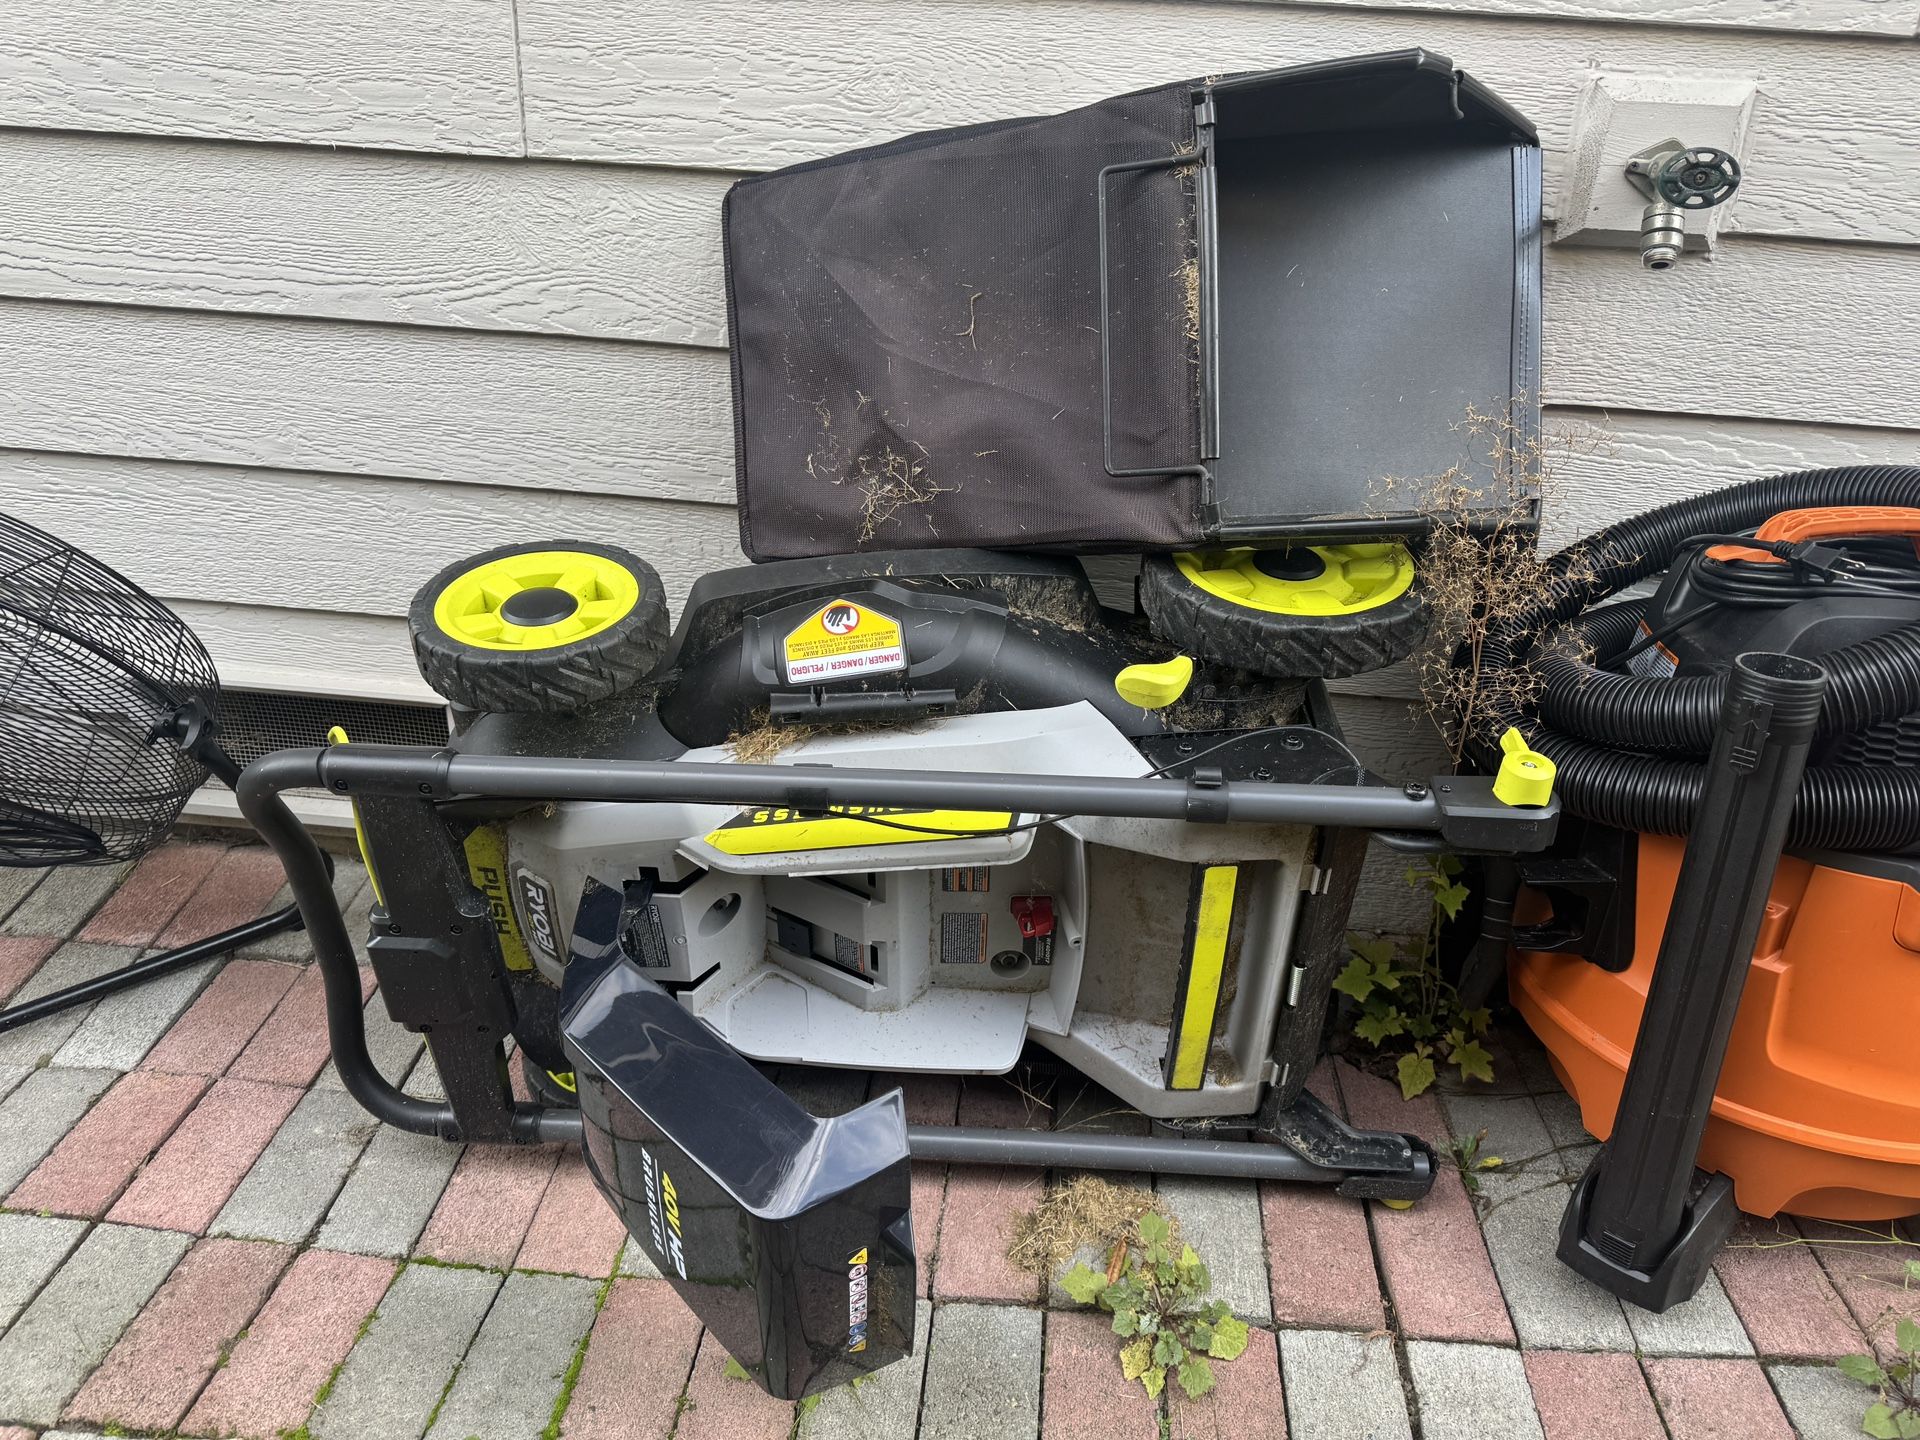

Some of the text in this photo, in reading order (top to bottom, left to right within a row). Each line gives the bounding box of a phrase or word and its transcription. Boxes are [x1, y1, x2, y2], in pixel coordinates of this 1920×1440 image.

[848, 643, 868, 651] HANDS
[831, 657, 864, 669] DANGER
[868, 653, 900, 664] DANGER
[791, 664, 824, 675] PELIGRO
[477, 866, 511, 935] PUSH
[525, 882, 557, 957] RYOBI
[650, 905, 660, 923] RYOBI
[641, 1147, 664, 1256] BRUSHLESS
